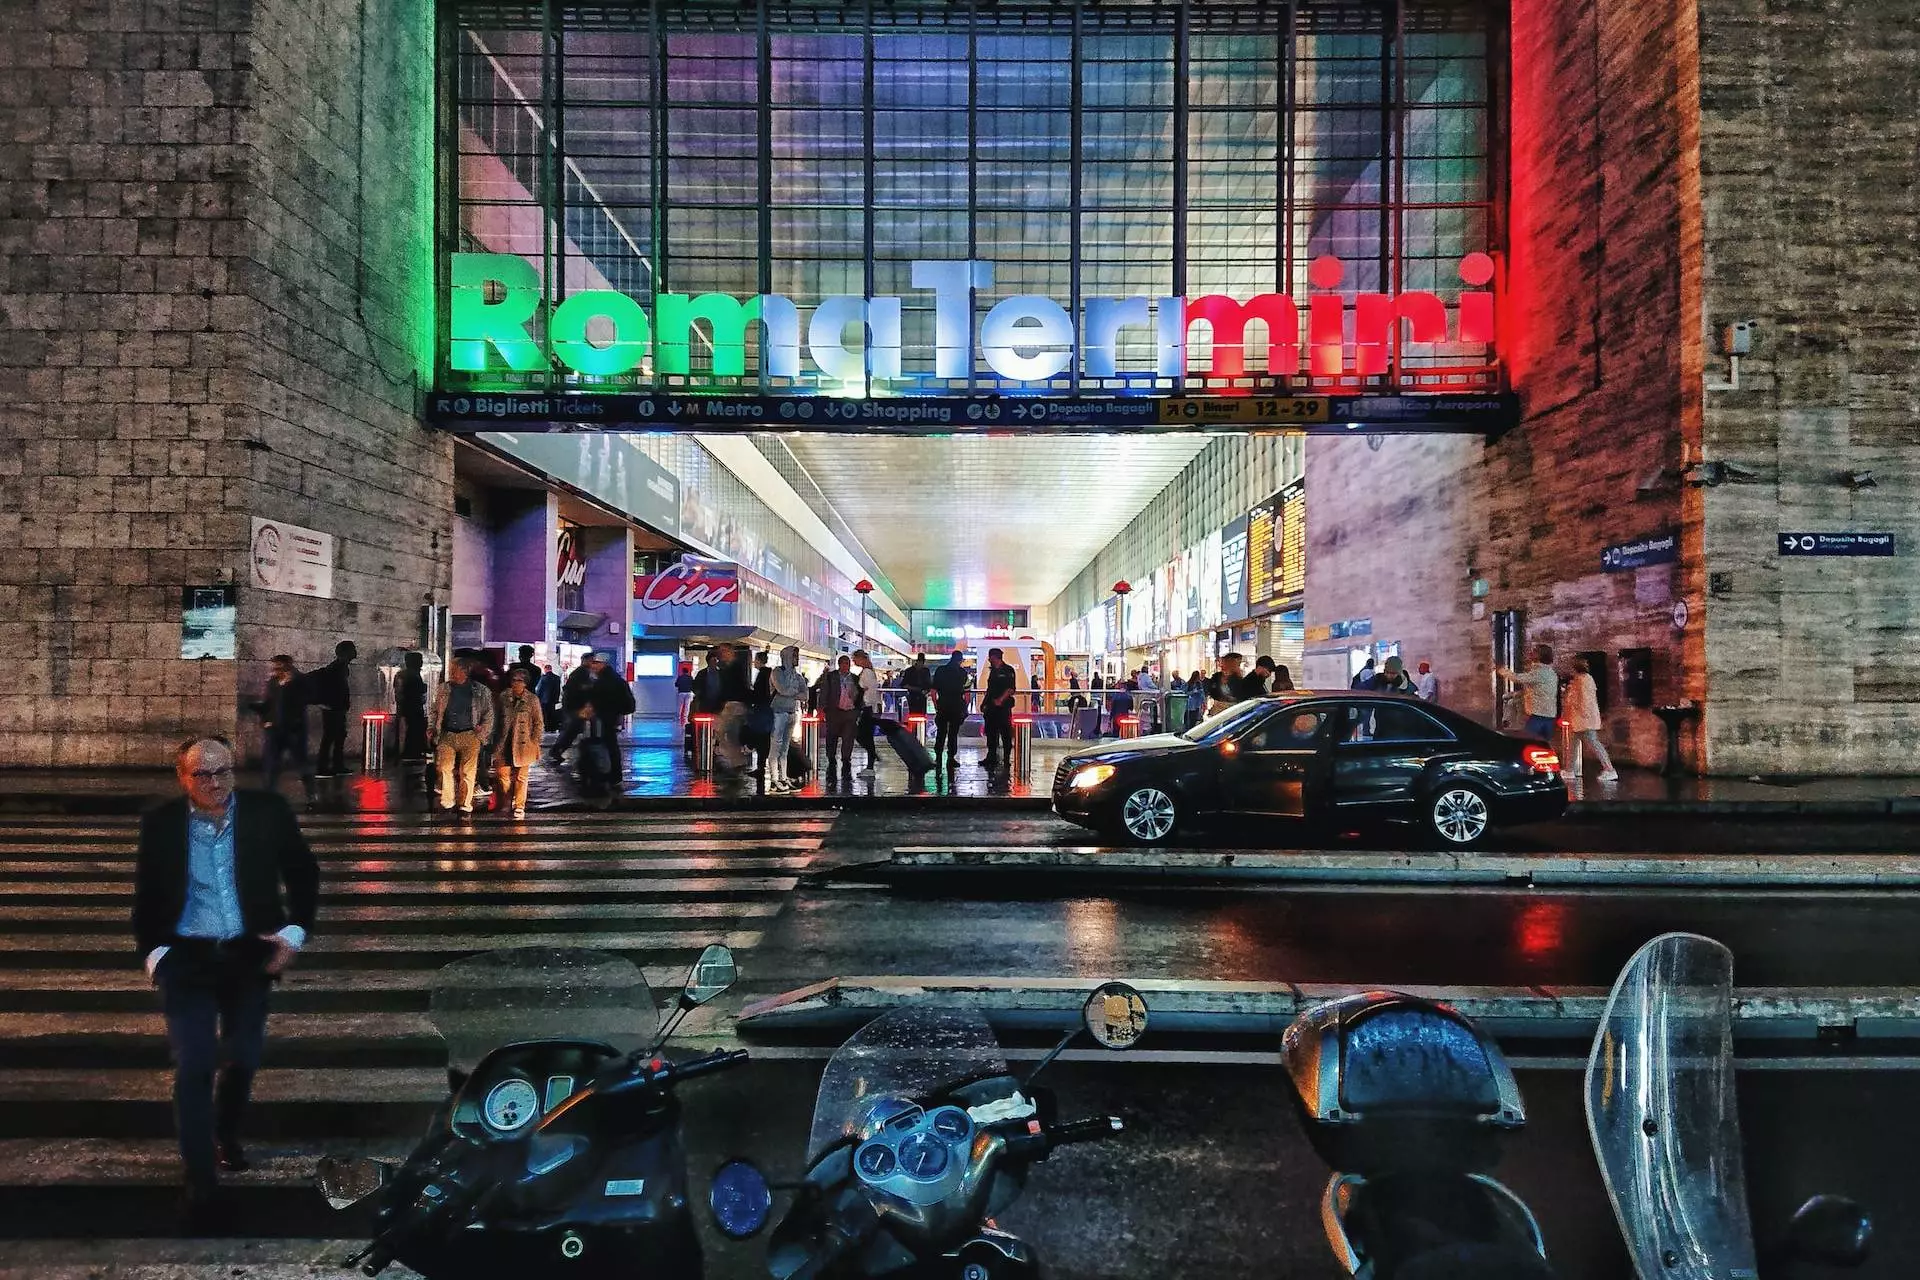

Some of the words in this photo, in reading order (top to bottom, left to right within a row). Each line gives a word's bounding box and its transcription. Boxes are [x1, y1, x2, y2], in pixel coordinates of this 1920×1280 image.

[475, 398, 549, 416] Biglietti
[555, 399, 603, 415] Tickets
[706, 401, 763, 416] Metro
[862, 402, 951, 422] Shopping
[1049, 402, 1103, 415] Deposito
[1105, 402, 1153, 415] Bagagli
[1435, 400, 1501, 412] Aeroporto
[1819, 535, 1856, 544] Deposito
[1858, 535, 1890, 545] Bagagli
[642, 562, 737, 610] Ciao
[926, 625, 964, 638] Rom
